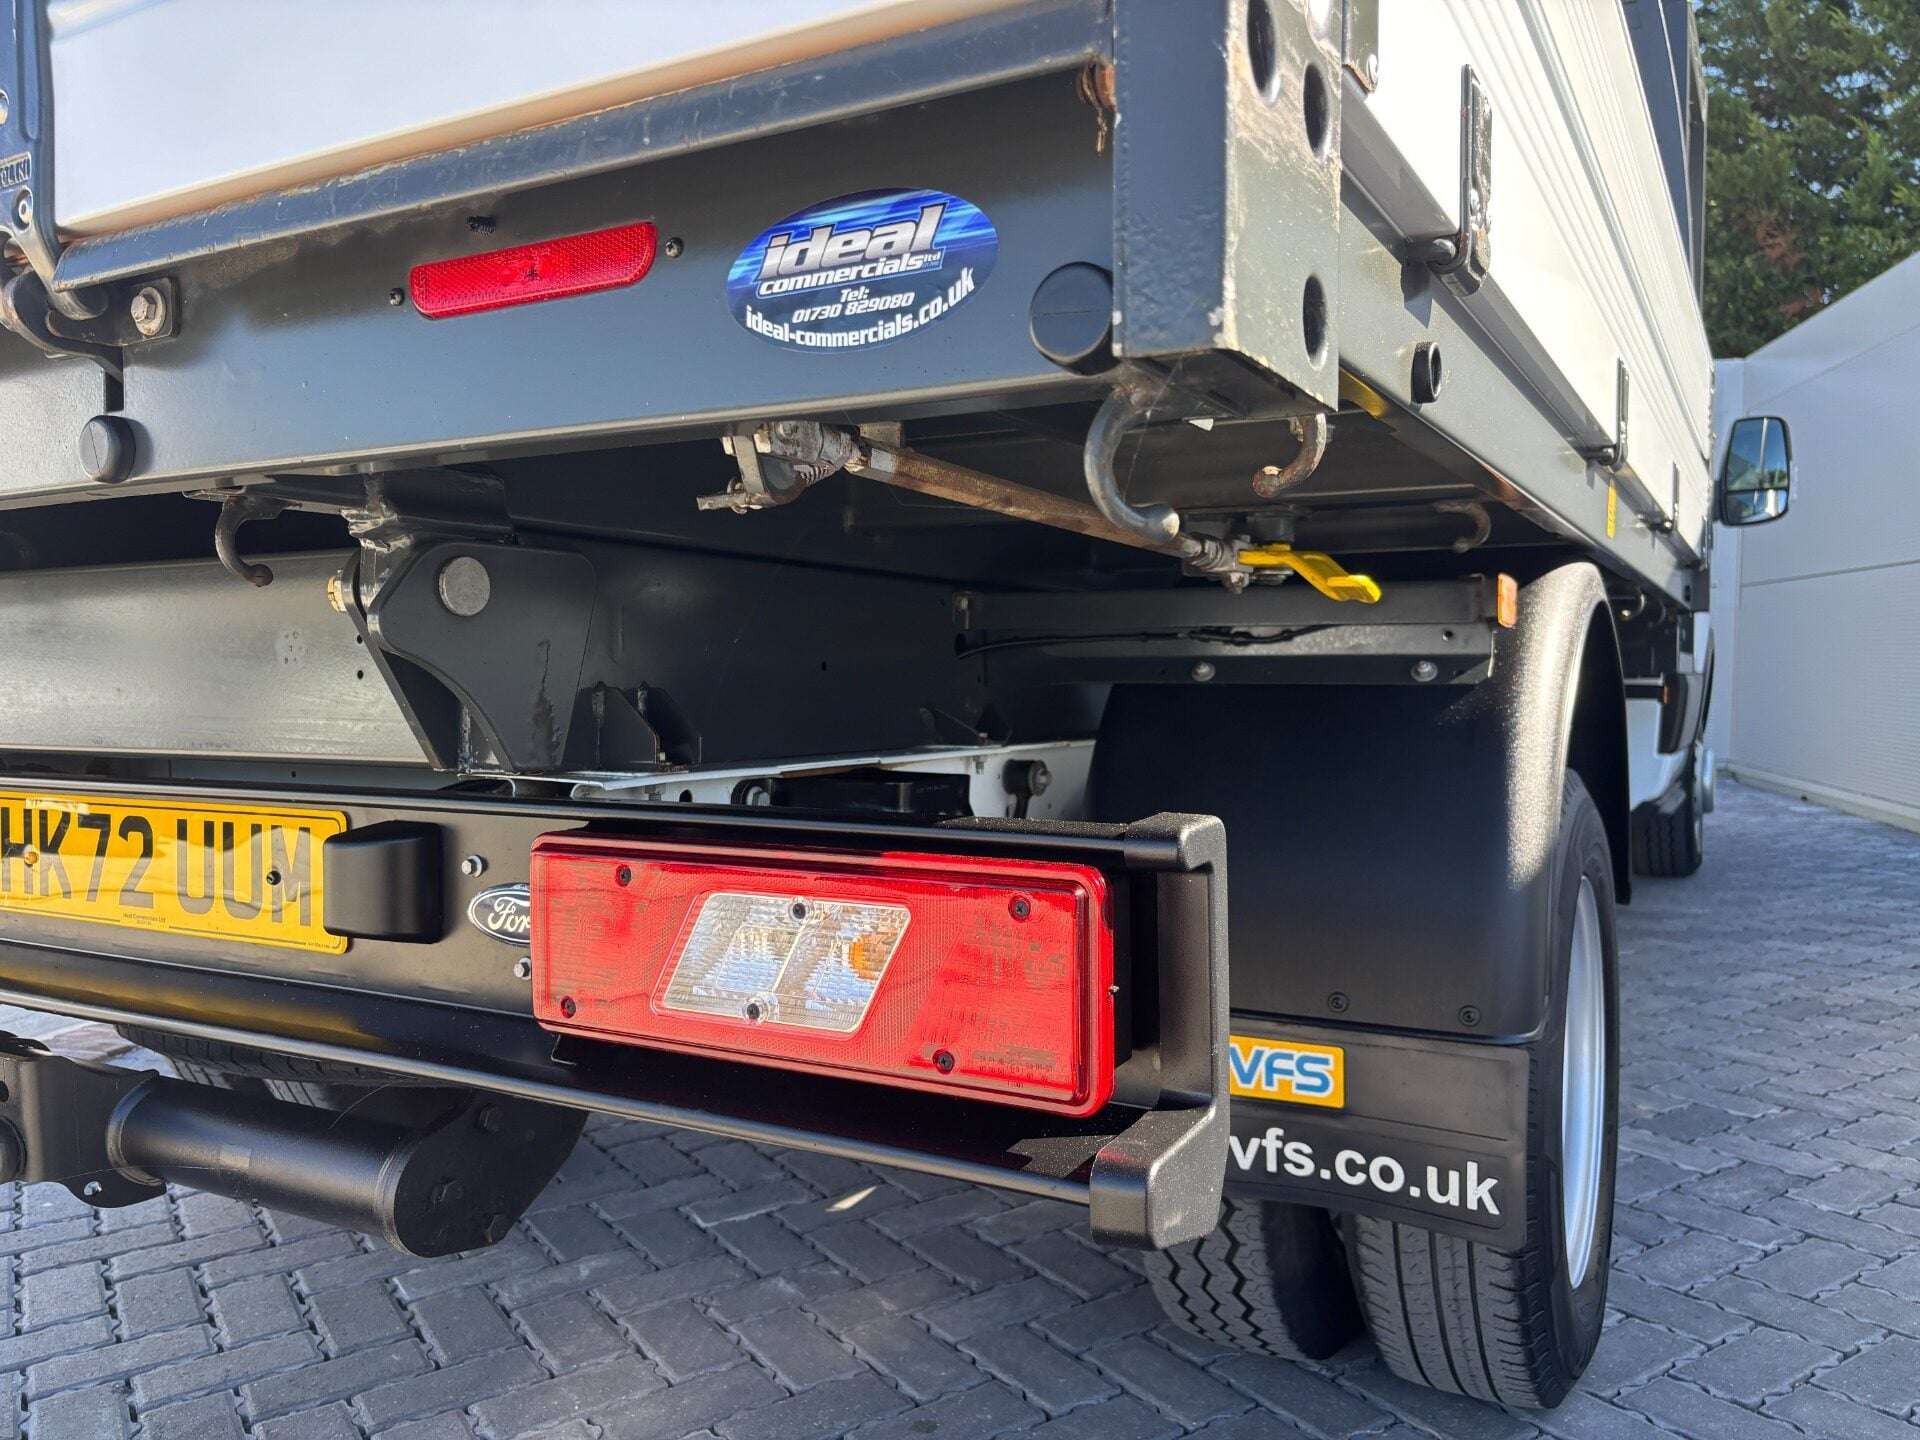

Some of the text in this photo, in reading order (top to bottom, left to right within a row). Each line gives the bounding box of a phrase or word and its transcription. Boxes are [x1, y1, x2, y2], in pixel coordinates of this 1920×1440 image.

[760, 203, 947, 279] ideal
[759, 253, 924, 295] commercials
[840, 286, 869, 303] Tel:
[746, 267, 975, 347] ideal-commercials.co.uk
[792, 292, 915, 323] 01730 829080
[0, 806, 311, 926] HK72 UUM
[487, 896, 531, 932] For
[1230, 1045, 1332, 1096] VFS
[1230, 1127, 1500, 1216] vfs.co.uk
